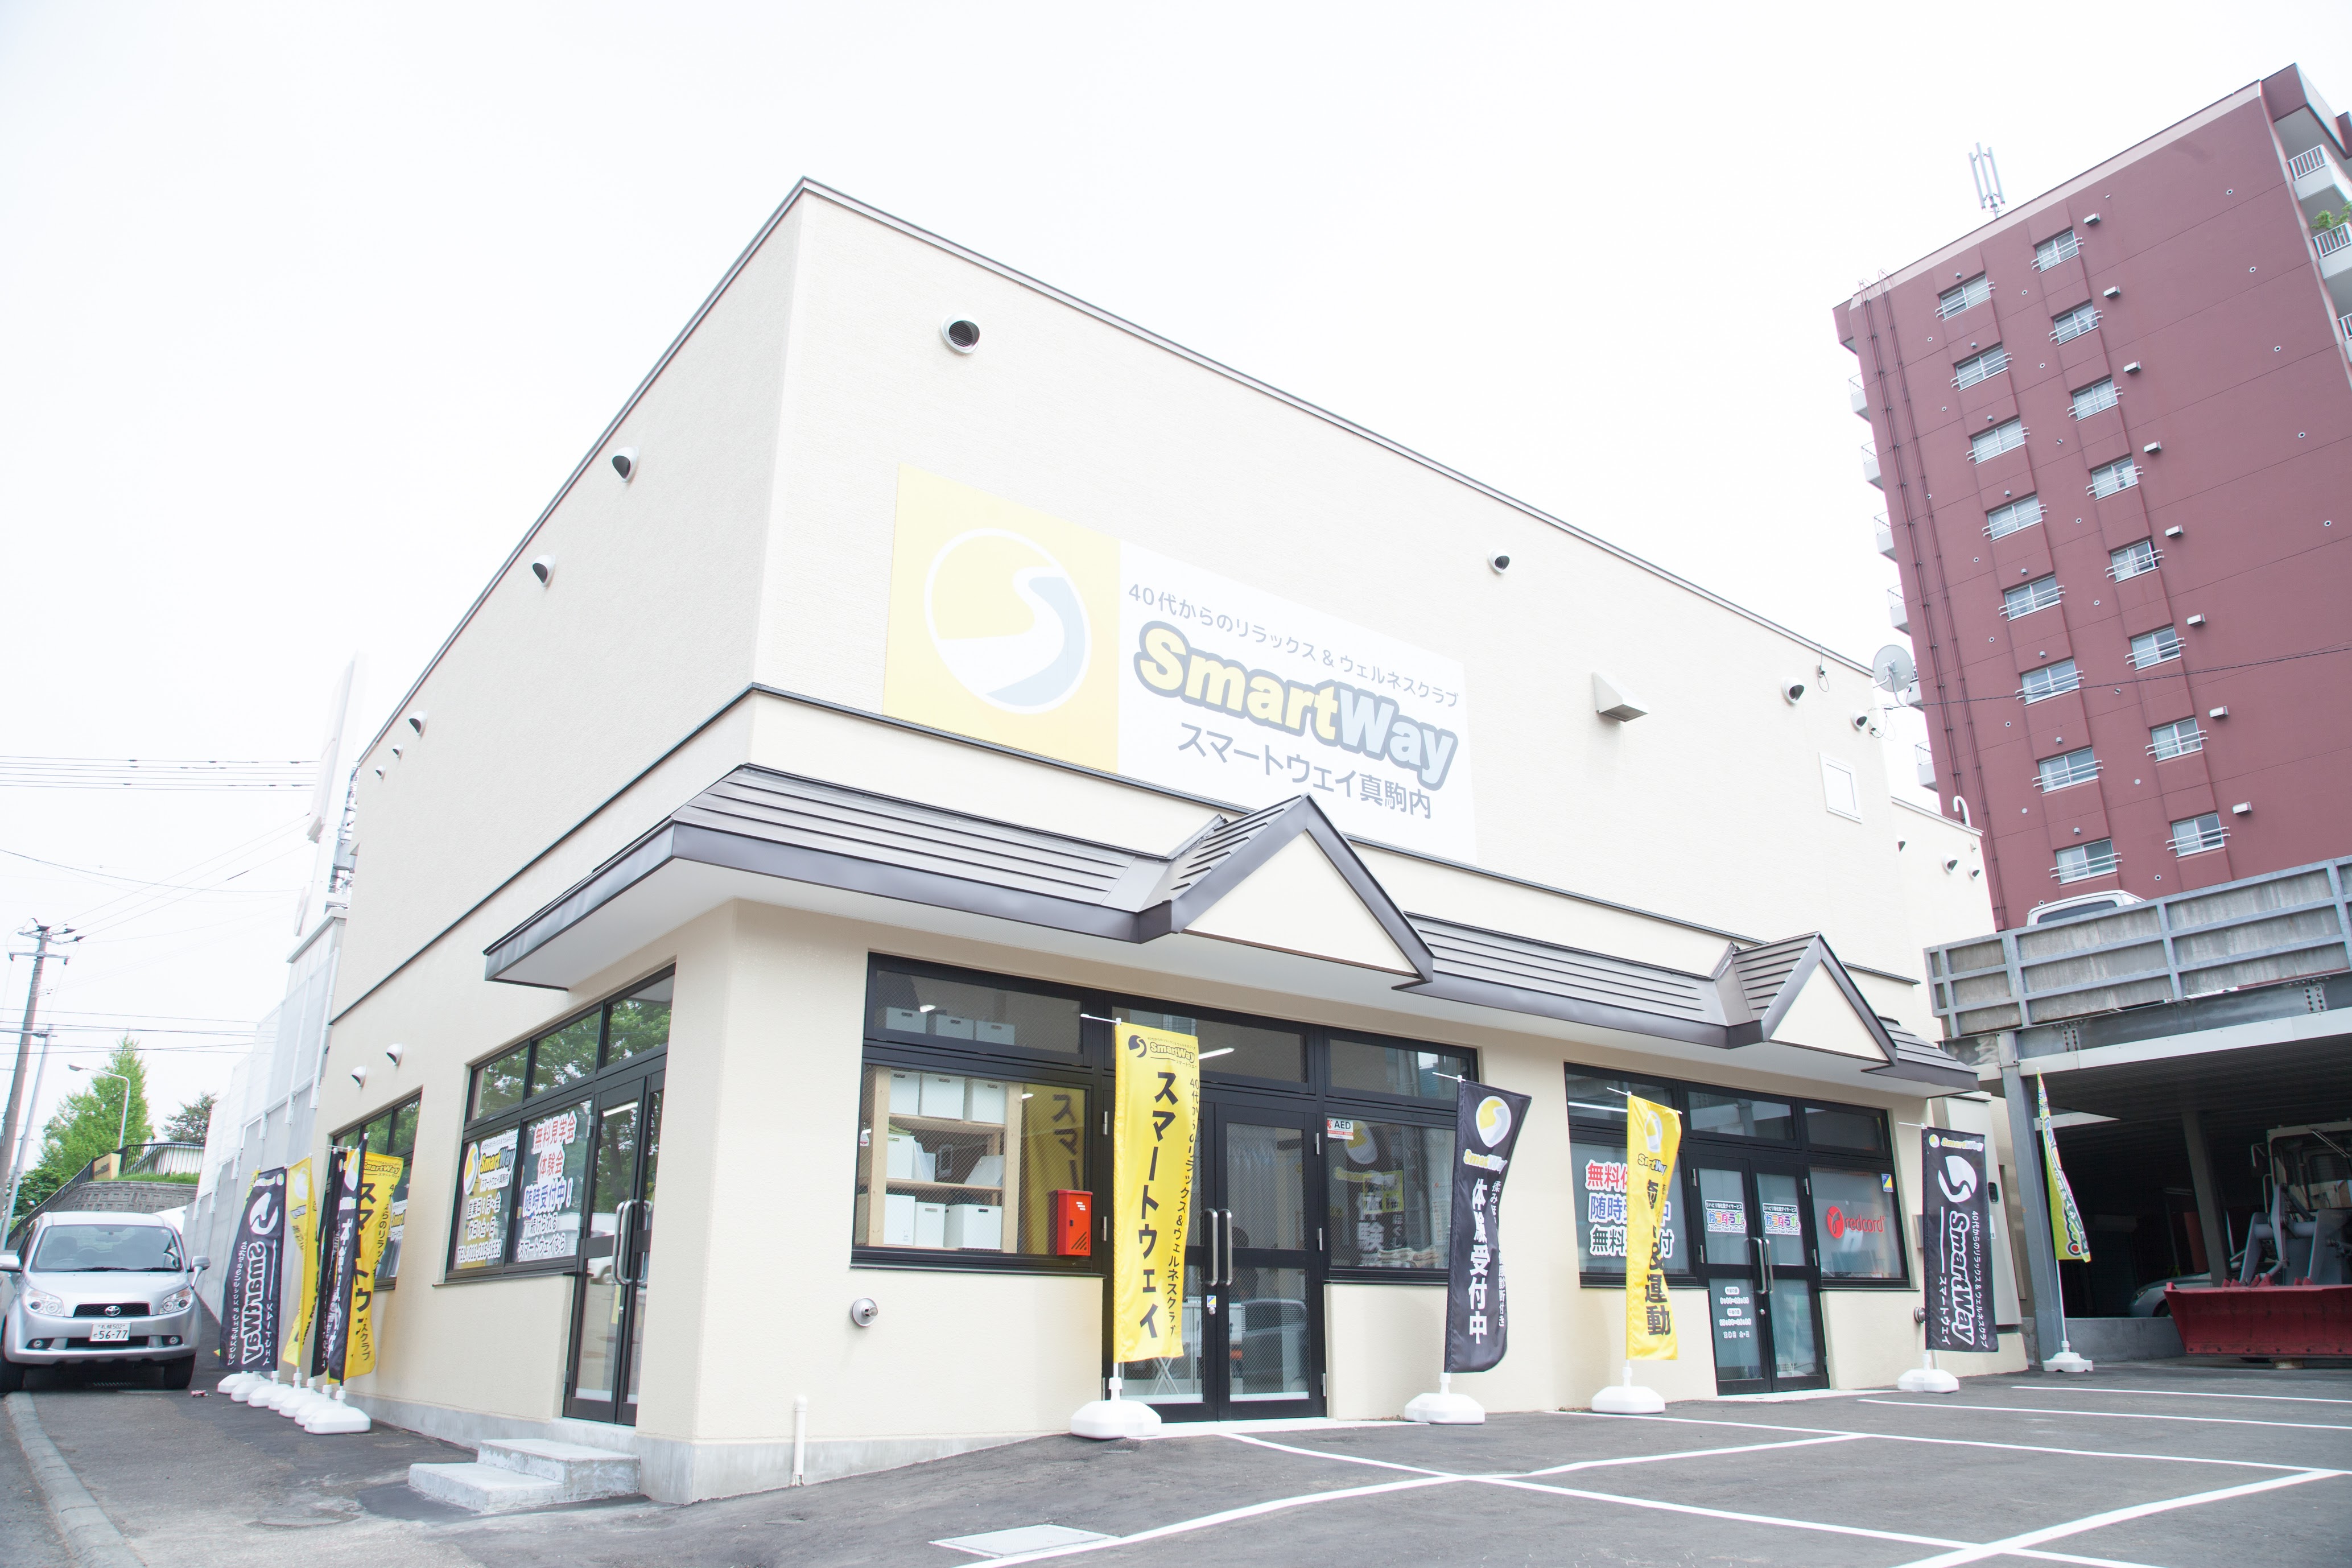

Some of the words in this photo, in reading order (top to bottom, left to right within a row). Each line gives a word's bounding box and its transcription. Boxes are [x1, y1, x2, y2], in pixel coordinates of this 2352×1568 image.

[1133, 620, 1458, 790] SmartWay
[1150, 1042, 1195, 1063] SmartWay
[535, 1115, 575, 1150] 無料見学会
[1334, 1120, 1351, 1129] AED
[1941, 1137, 1984, 1152] SmartWay
[480, 1146, 515, 1174] SmartWay
[539, 1150, 564, 1179] 体験会
[1138, 1071, 1179, 1339] スマートウェイ
[518, 1235, 566, 1257] スマートウェイなら
[1468, 1178, 1491, 1344] 体験受付中
[1949, 1210, 1975, 1346] SmartWay
[99, 1330, 128, 1339] 56-77
